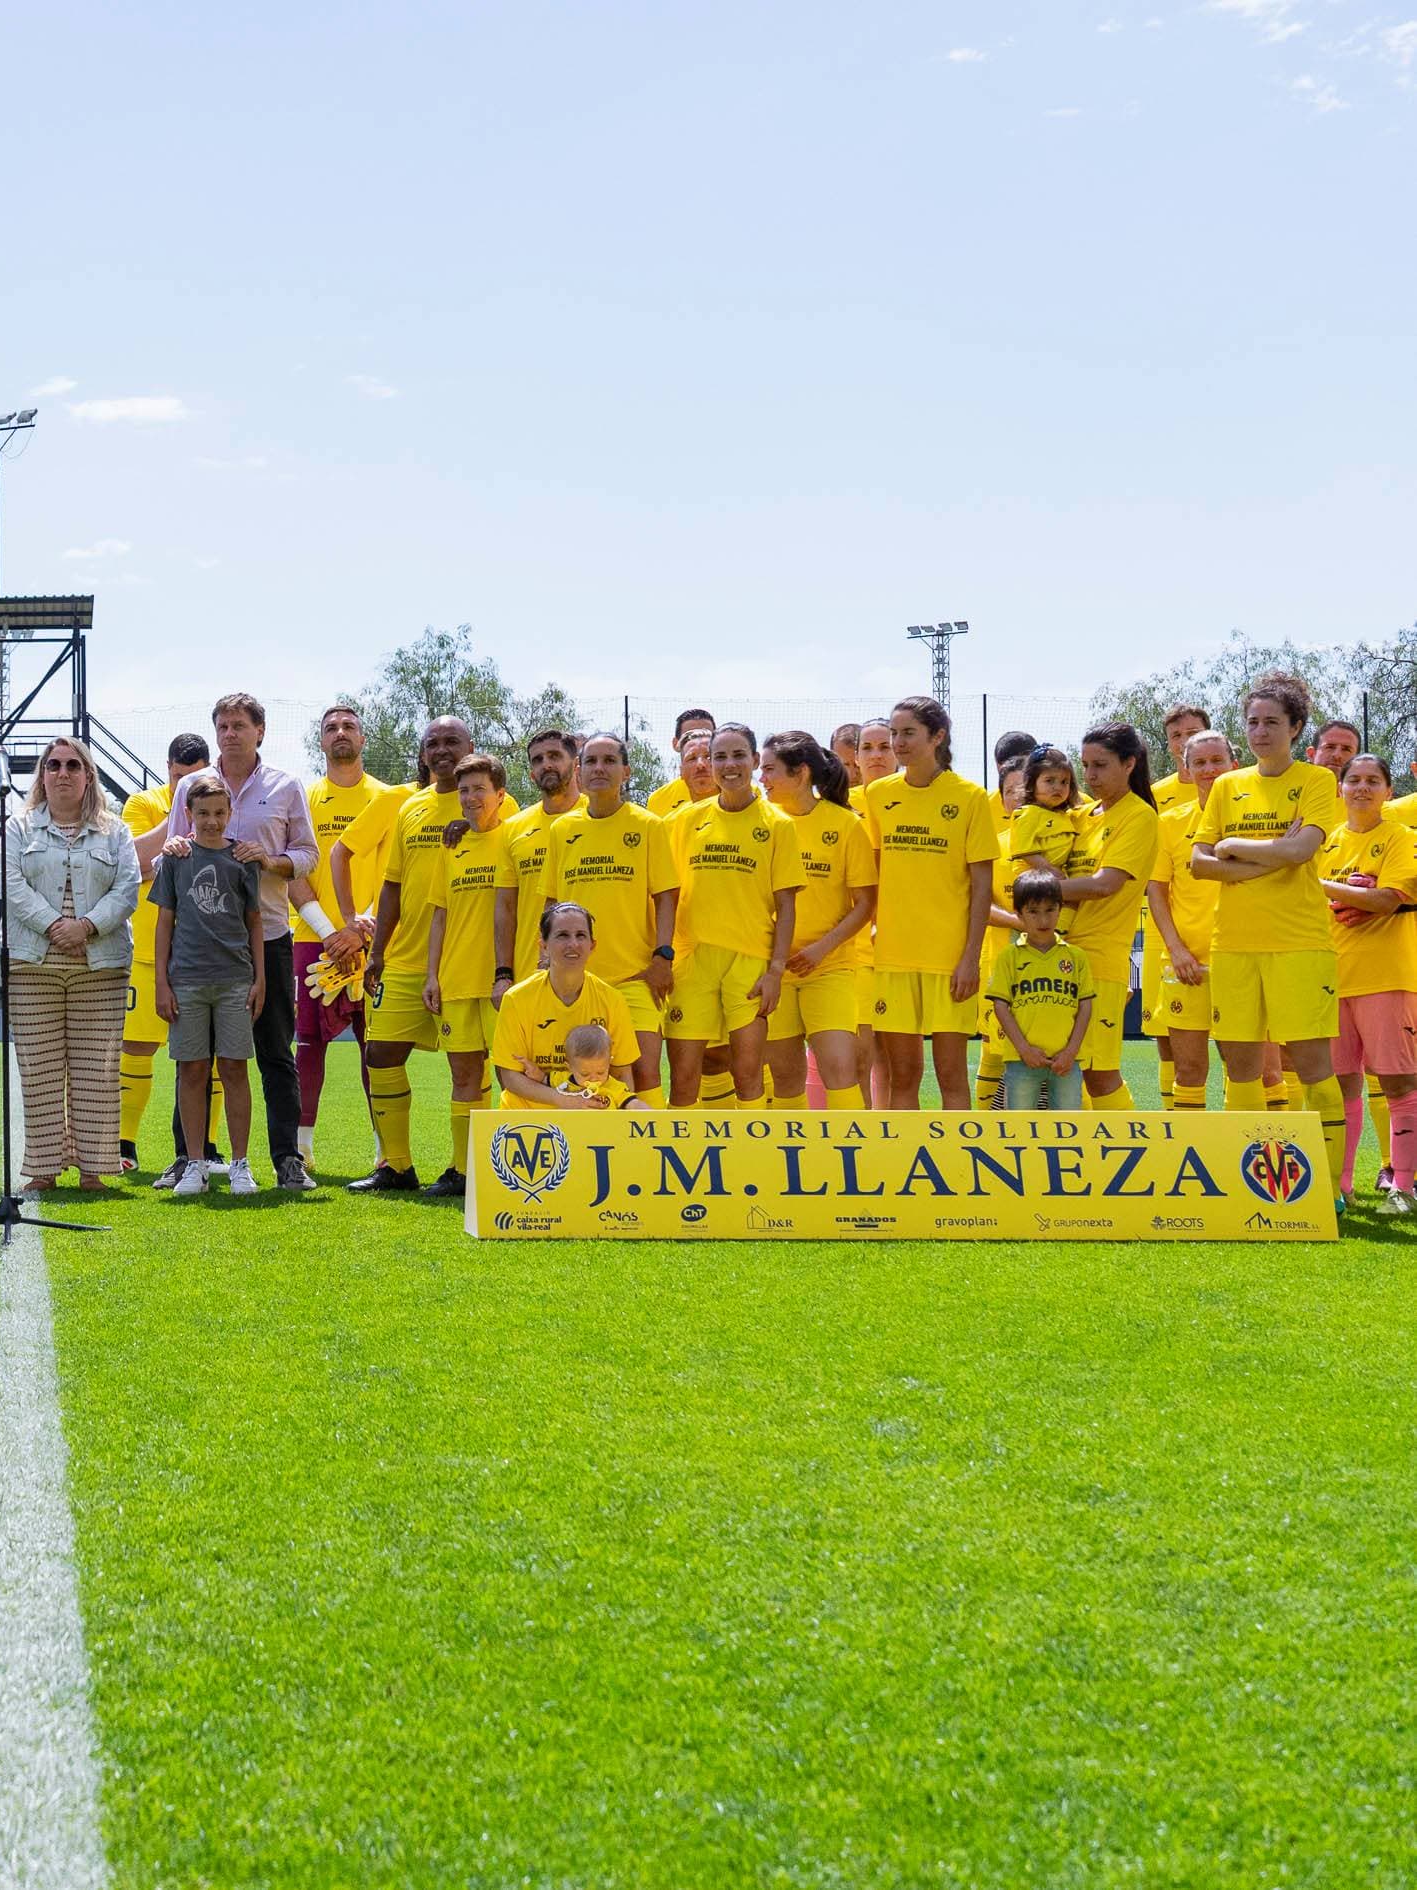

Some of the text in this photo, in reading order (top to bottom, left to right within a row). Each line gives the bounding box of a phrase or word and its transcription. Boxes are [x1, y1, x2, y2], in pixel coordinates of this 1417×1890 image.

[1238, 821, 1265, 831] MANUEL
[580, 855, 614, 865] MEMORIAL
[702, 854, 729, 864] MANUEL
[730, 855, 757, 870] LLANEZA
[577, 866, 604, 876] MANUEL
[605, 866, 635, 875] LLANEZA
[803, 861, 831, 873] LANEZA
[462, 875, 486, 885] MANUEL
[628, 1121, 1174, 1139] MEMORIAL SOLIDARI
[776, 1145, 1228, 1197] LLANEZA
[517, 1223, 551, 1231] vila-real
[767, 1218, 794, 1228] D&R
[1166, 1217, 1204, 1228] ROOTS
